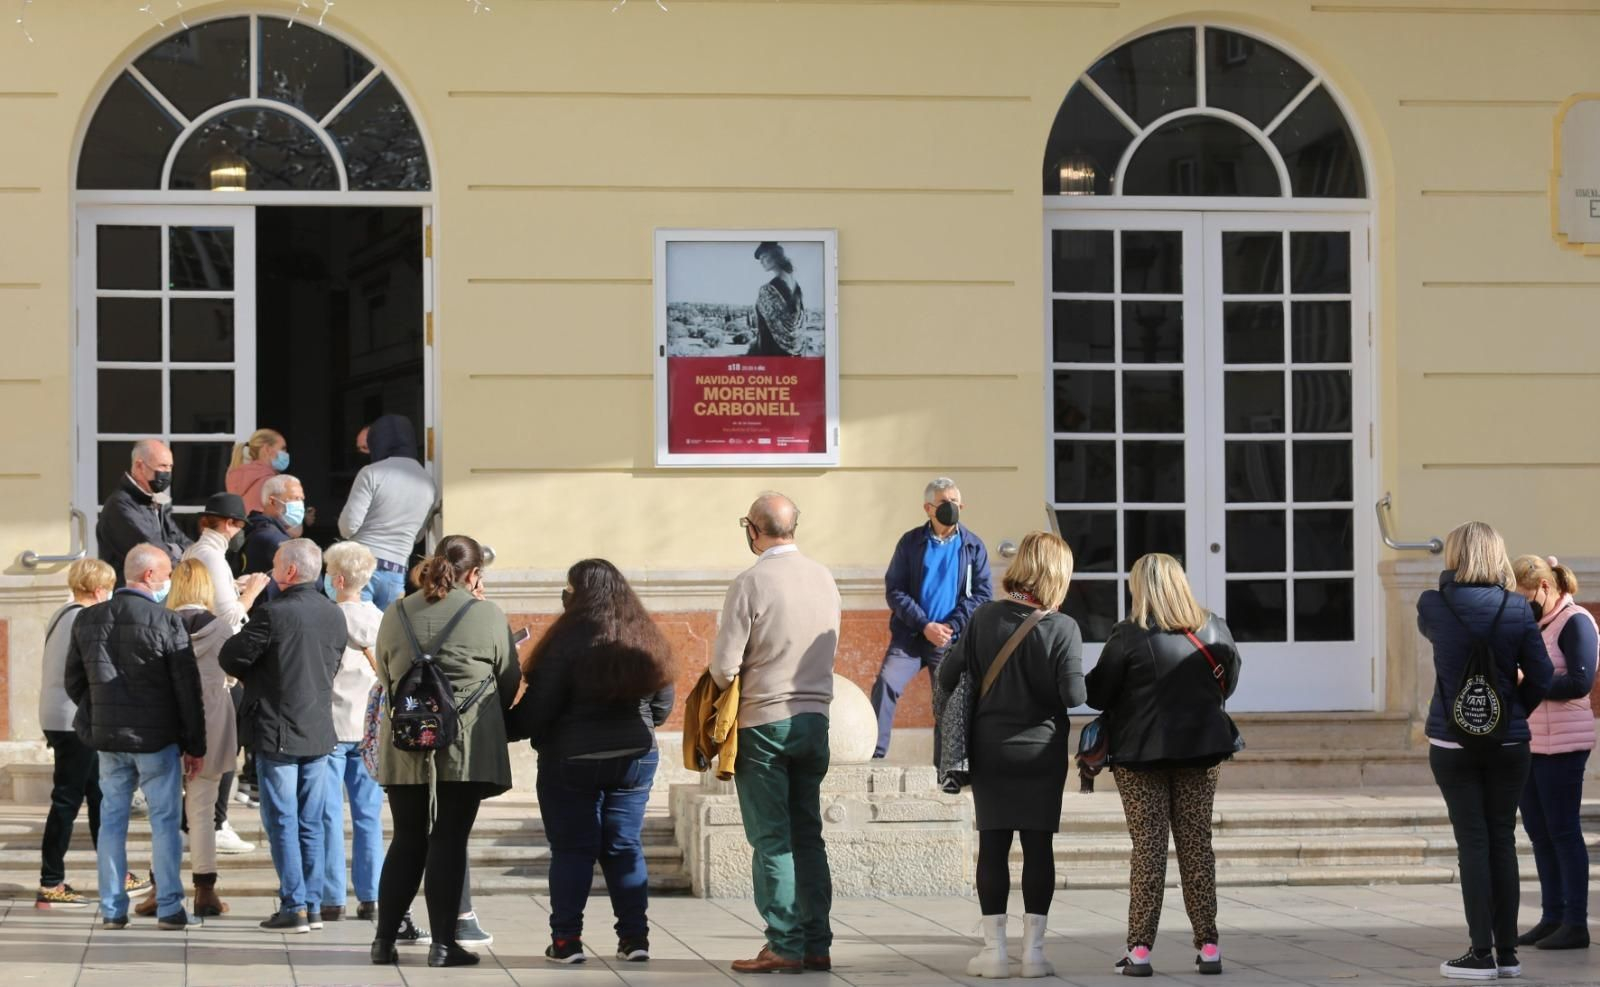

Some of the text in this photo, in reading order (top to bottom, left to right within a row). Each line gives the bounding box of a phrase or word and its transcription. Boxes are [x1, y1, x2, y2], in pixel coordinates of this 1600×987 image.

[695, 375, 798, 385] NAVIDAD CON LOS
[703, 387, 790, 401] MORENTE
[693, 402, 800, 416] CARBONELL
